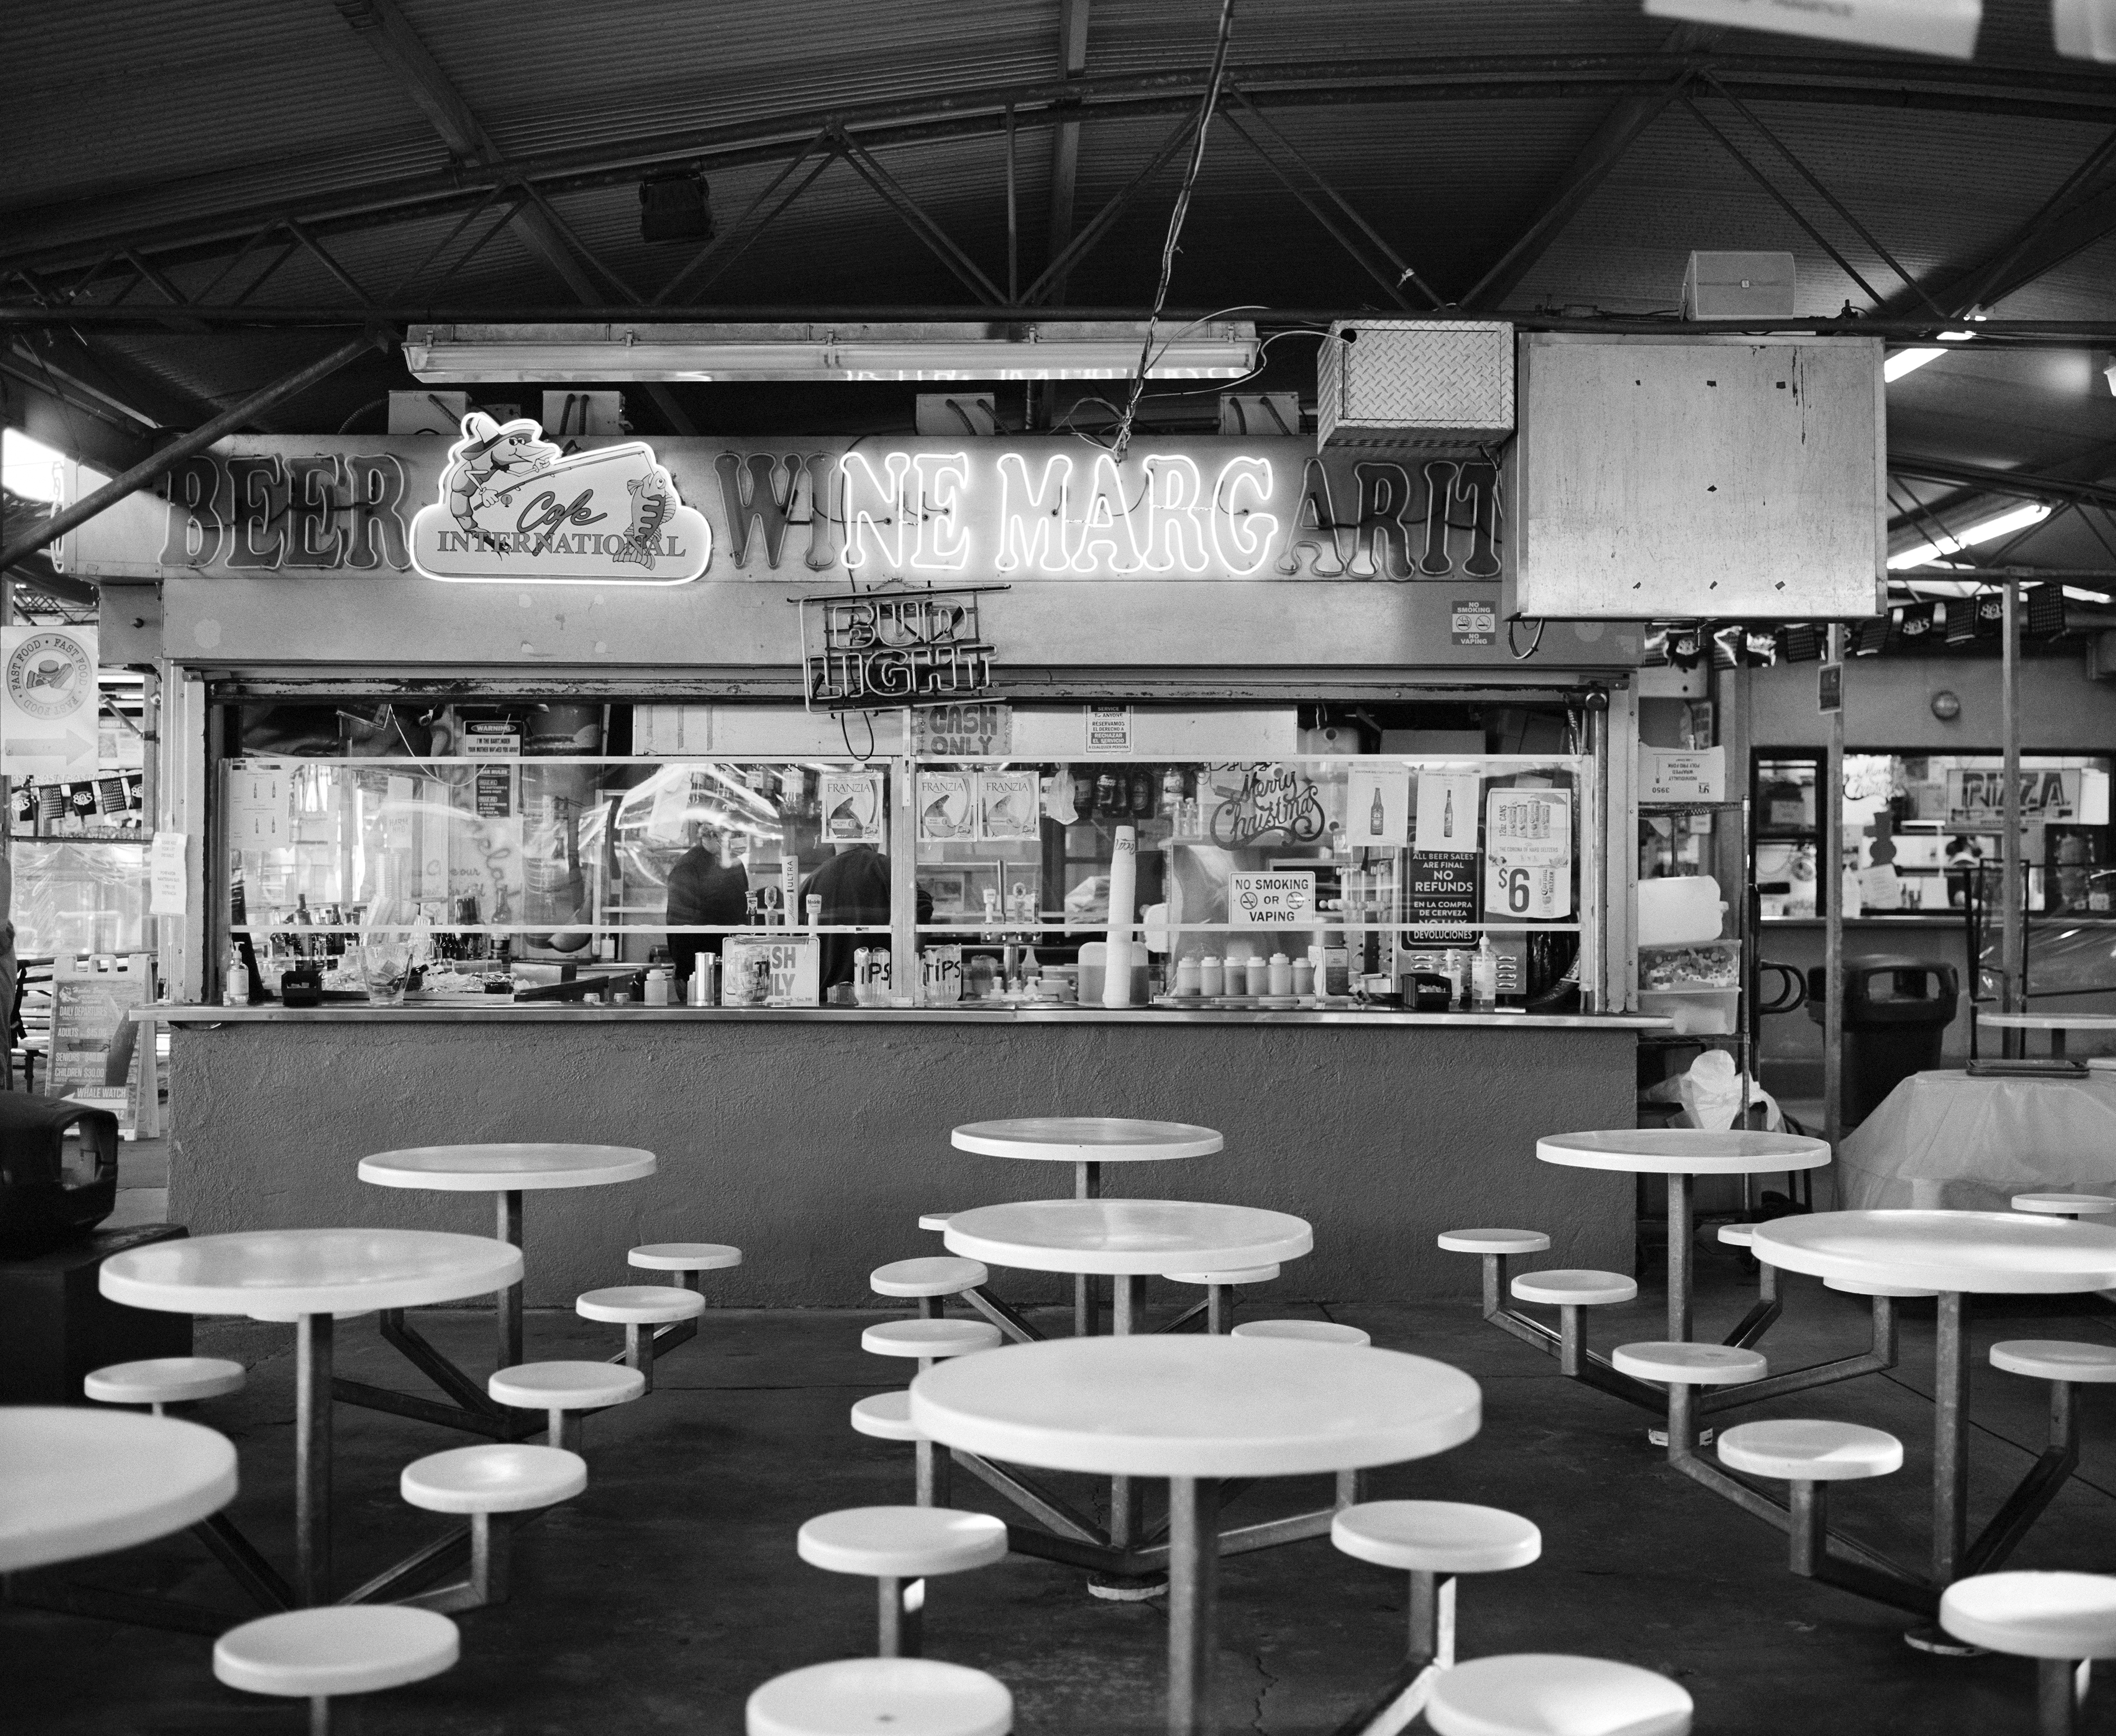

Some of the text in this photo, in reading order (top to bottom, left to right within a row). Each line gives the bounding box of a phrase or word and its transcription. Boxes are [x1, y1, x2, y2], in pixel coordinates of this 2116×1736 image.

[159, 454, 412, 572] BEER
[713, 452, 969, 570] WINE
[516, 489, 607, 556] Cafe
[437, 531, 686, 557] INTERNATIONAL
[1980, 603, 2003, 619] 80
[833, 598, 969, 648] BUD
[11, 639, 41, 691] FAST FOOD
[53, 638, 88, 686] FAST FOOD
[807, 643, 998, 699] LIGHT
[929, 706, 998, 735] CASH
[931, 736, 993, 755] ONLY
[131, 786, 142, 798] 80
[827, 783, 871, 795] FRANZIA
[922, 782, 964, 793] FRANZIA
[986, 782, 1028, 793] FRANZIA
[1232, 771, 1298, 803] Merry
[11, 799, 30, 810] 805
[73, 792, 93, 805] 805
[1210, 786, 1325, 851] Christmas
[1434, 870, 1454, 880] NO
[1235, 879, 1309, 890] NO SMOKING
[1415, 881, 1473, 892] REFUNDS
[1498, 867, 1530, 913] $6
[1264, 896, 1279, 904] OR
[1249, 911, 1295, 922] VAPING
[1413, 930, 1472, 939] DEVOLUCIONES
[59, 1006, 107, 1016] DAILY DEPARTURES
[58, 1028, 106, 1037] ADULTS $45.00
[56, 1052, 106, 1062] SENIORS $40.00
[54, 1067, 104, 1077] CHILDREN $30.00
[77, 1088, 126, 1098] WHALE WATCH
[120, 1110, 124, 1119] 2
